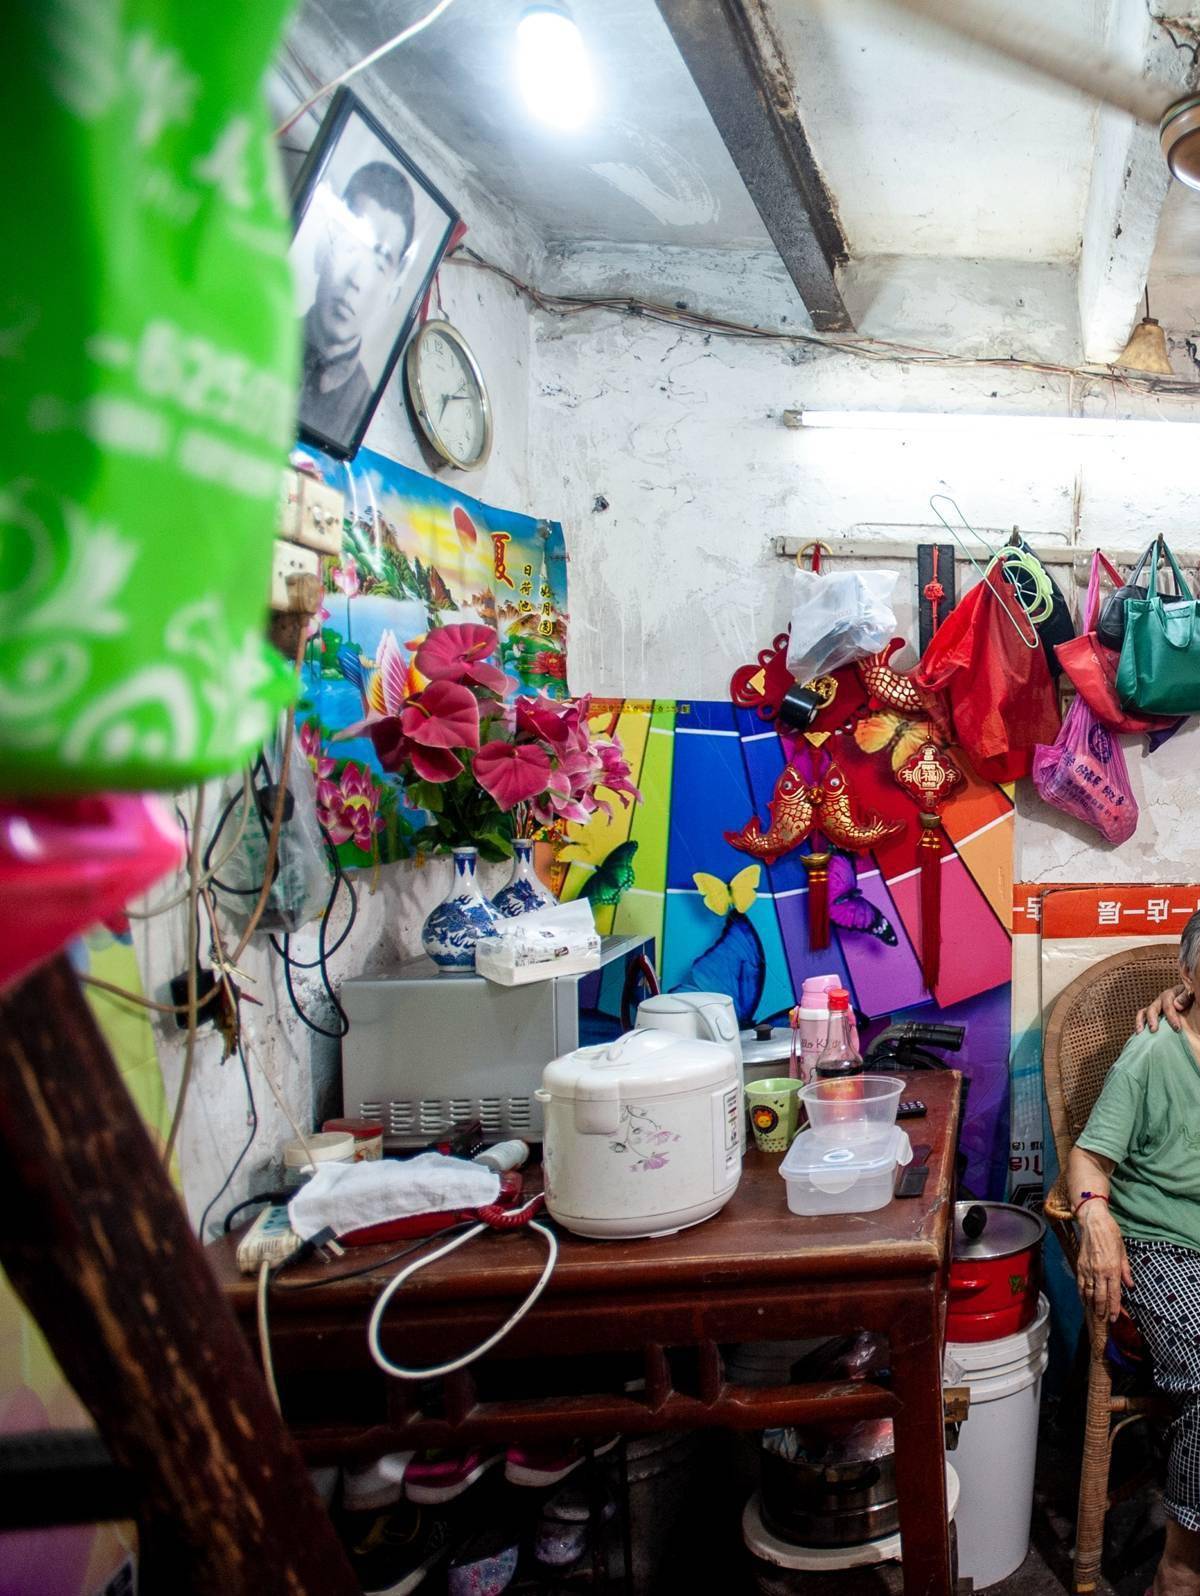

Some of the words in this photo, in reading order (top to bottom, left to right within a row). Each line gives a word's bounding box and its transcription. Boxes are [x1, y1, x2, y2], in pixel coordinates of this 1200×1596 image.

[491, 532, 515, 589] 夏
[519, 564, 532, 612] 日荷池
[539, 572, 553, 636] 好月圆
[902, 770, 913, 782] 有
[920, 769, 937, 782] 福
[945, 769, 957, 783] 余
[922, 747, 936, 761] 富
